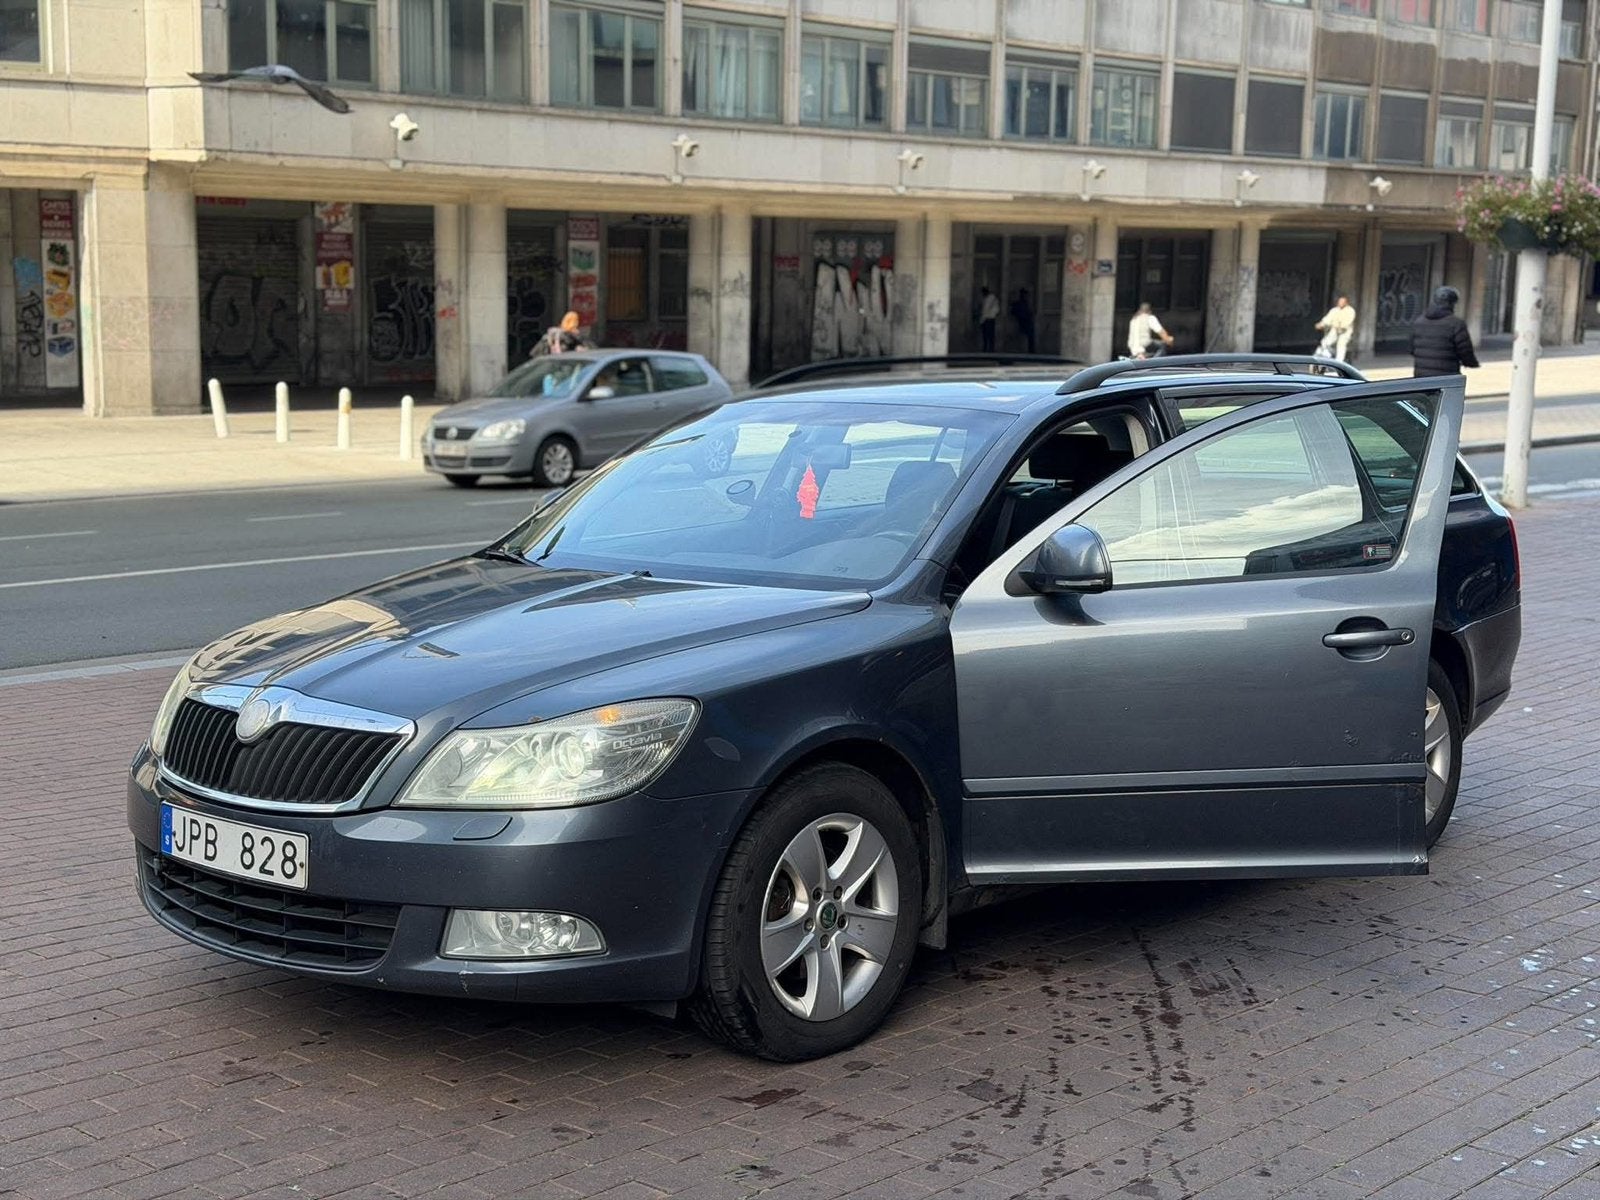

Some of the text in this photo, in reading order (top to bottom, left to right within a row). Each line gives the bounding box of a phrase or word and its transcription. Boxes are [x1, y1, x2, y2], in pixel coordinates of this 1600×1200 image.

[612, 732, 662, 750] Octavia
[165, 834, 170, 846] S
[174, 816, 298, 880] JPB 828
